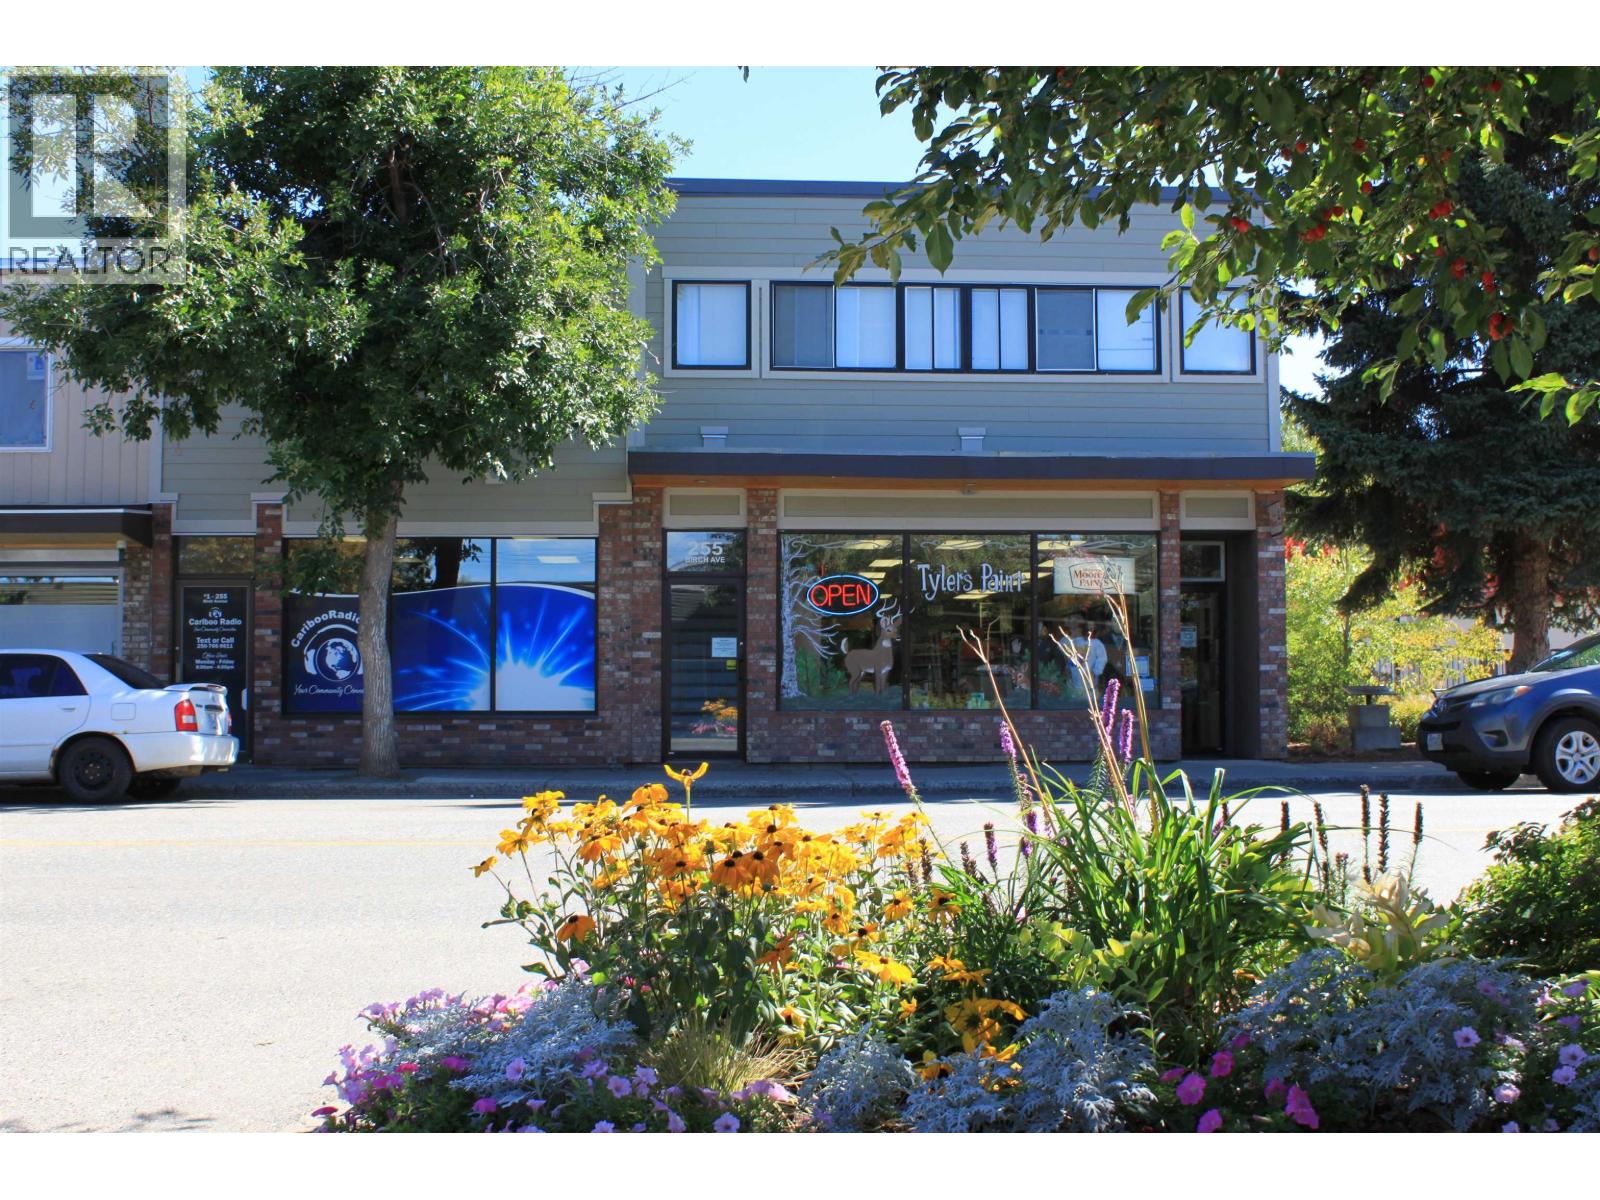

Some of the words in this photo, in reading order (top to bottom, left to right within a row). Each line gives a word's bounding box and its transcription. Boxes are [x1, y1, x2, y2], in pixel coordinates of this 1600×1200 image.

[688, 541, 723, 555] 255
[980, 562, 1024, 593] Paint
[810, 584, 871, 607] OPEN
[189, 618, 218, 626] Cariboo
[220, 618, 242, 626] Radio
[196, 636, 211, 644] Text
[221, 636, 235, 644] Call
